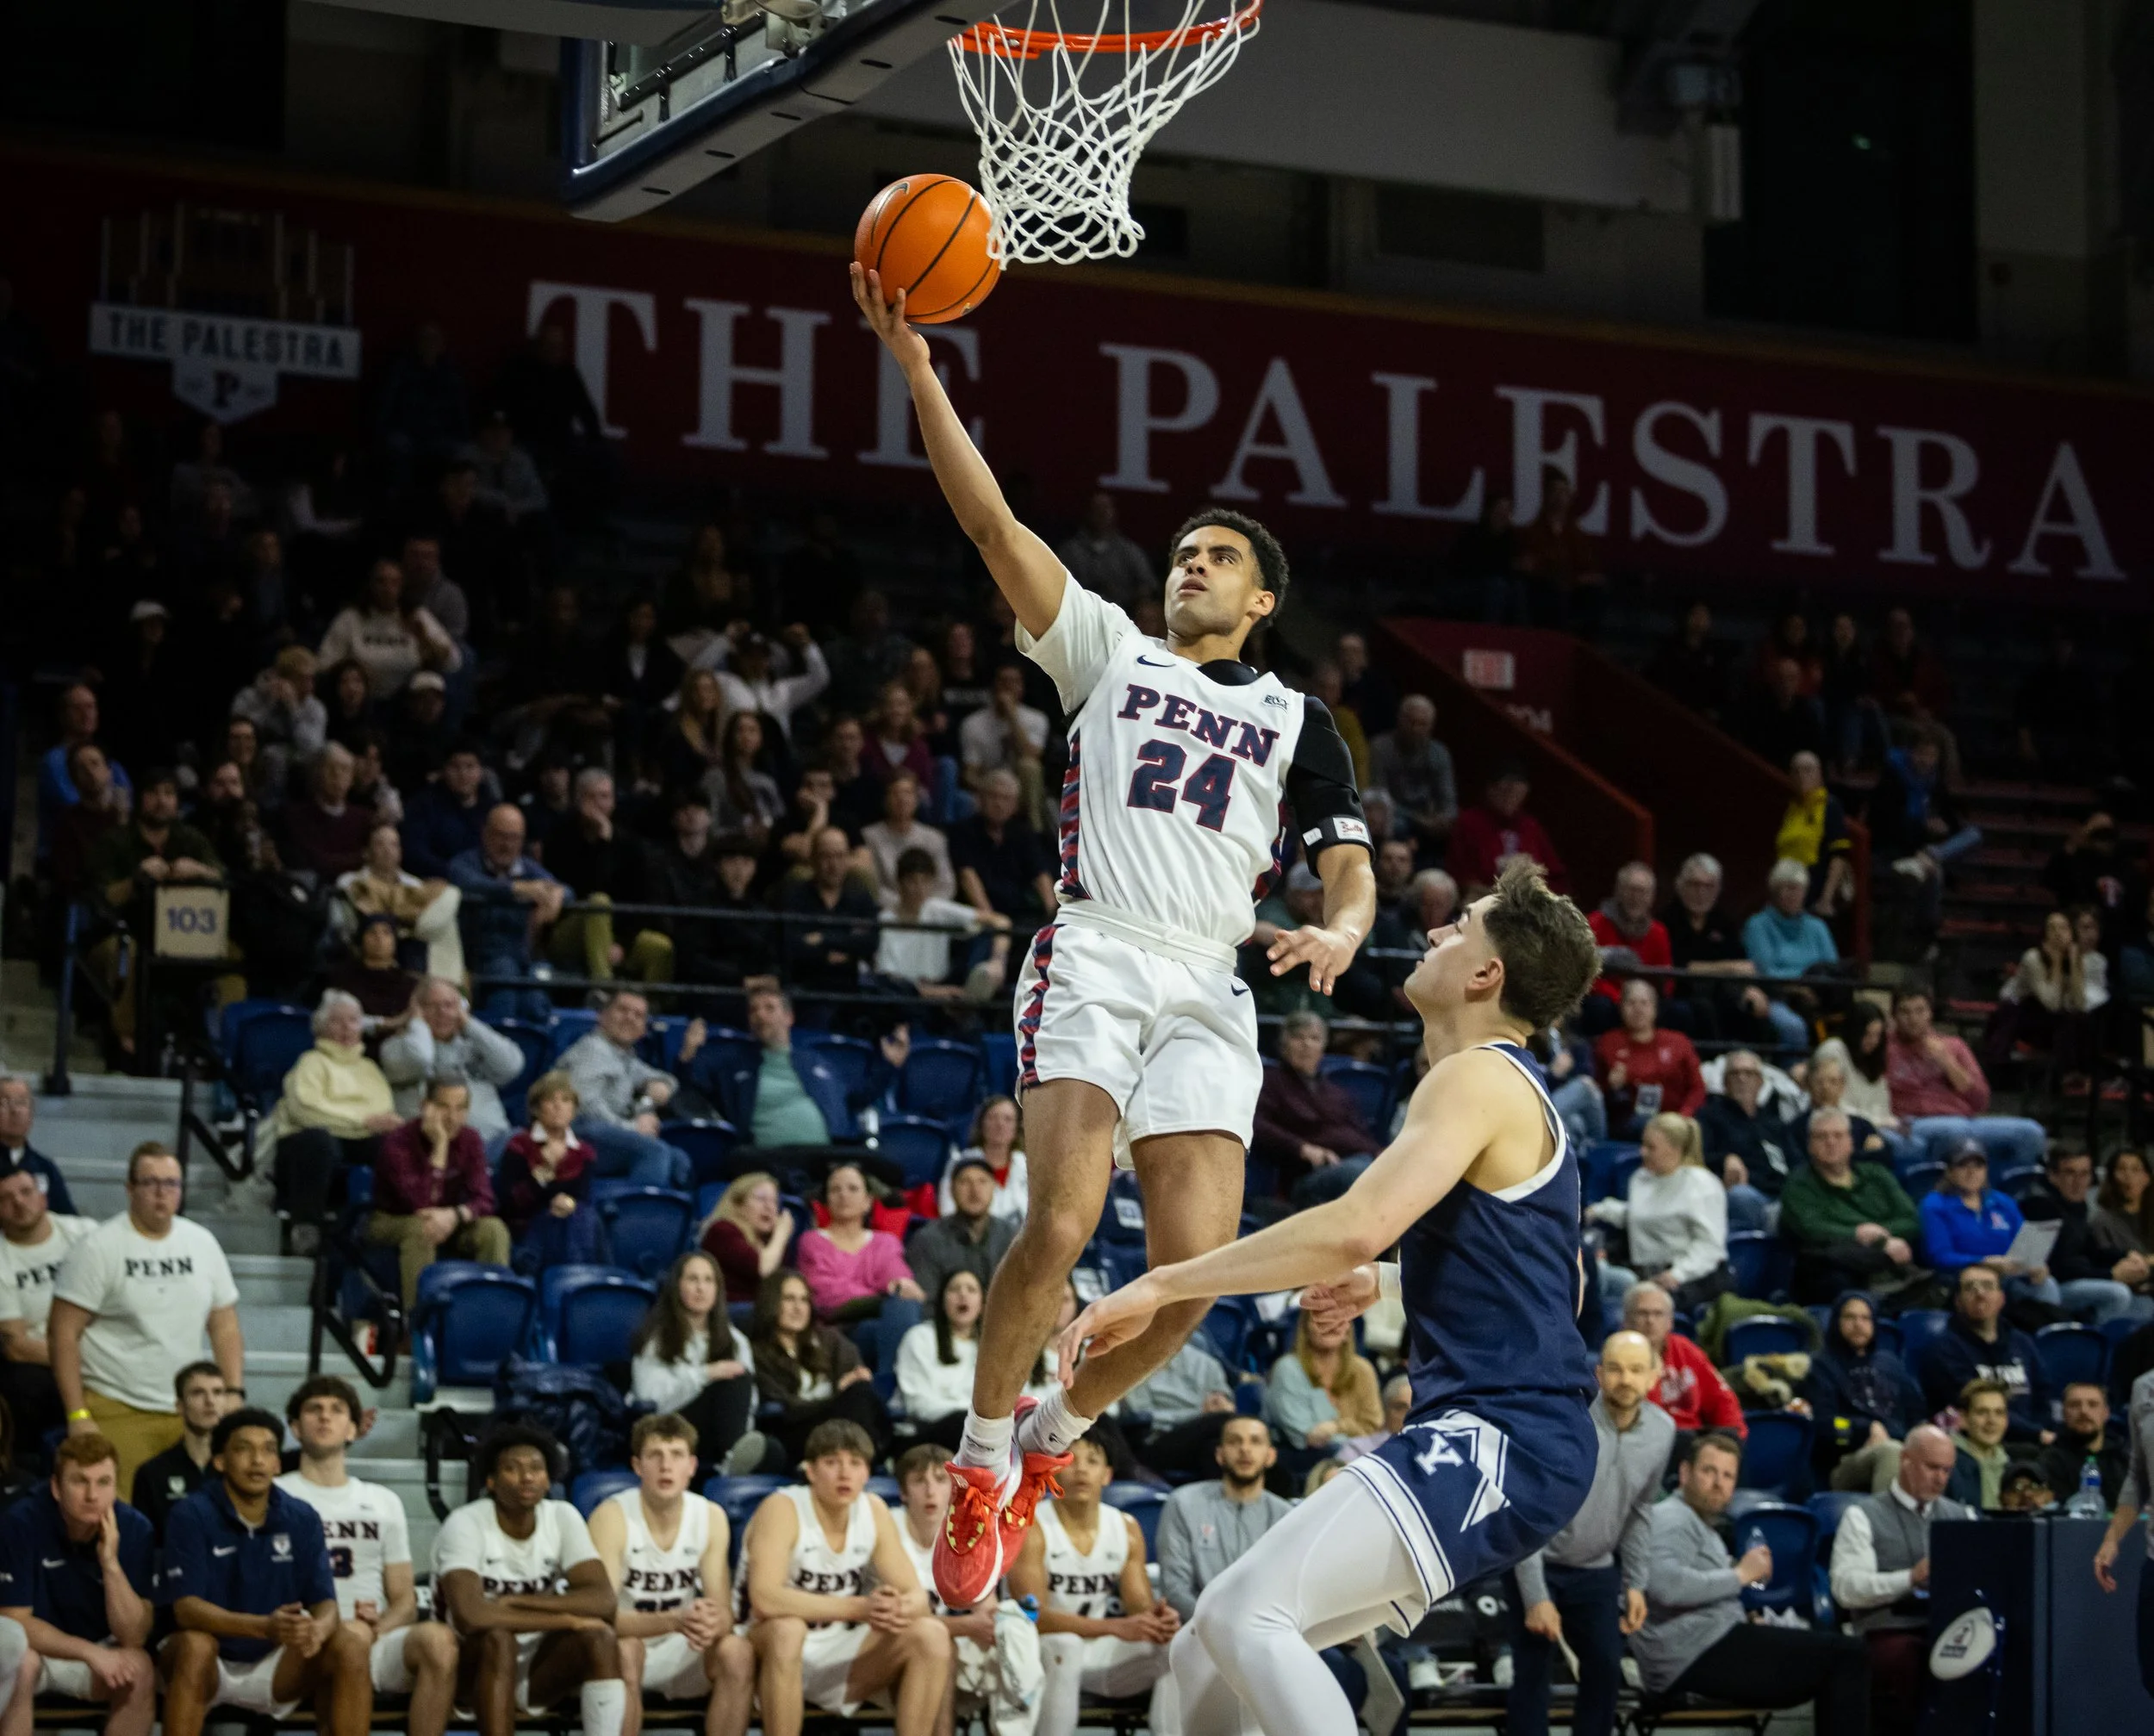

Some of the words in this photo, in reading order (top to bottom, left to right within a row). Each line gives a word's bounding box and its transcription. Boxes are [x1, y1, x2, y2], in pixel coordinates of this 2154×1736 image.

[109, 310, 167, 352] THE
[182, 318, 342, 368] PALESTRA
[214, 371, 240, 409] P
[1096, 341, 2129, 583] PALESTRA
[1117, 683, 1281, 768] PENN
[1127, 738, 1237, 833] 24
[167, 905, 217, 936] 103
[16, 1261, 63, 1290] PEN
[125, 1257, 193, 1278] PENN
[1414, 1431, 1465, 1477] Y
[322, 1521, 379, 1540] ENN
[624, 1567, 696, 1591] PENN
[794, 1567, 863, 1594] PENN
